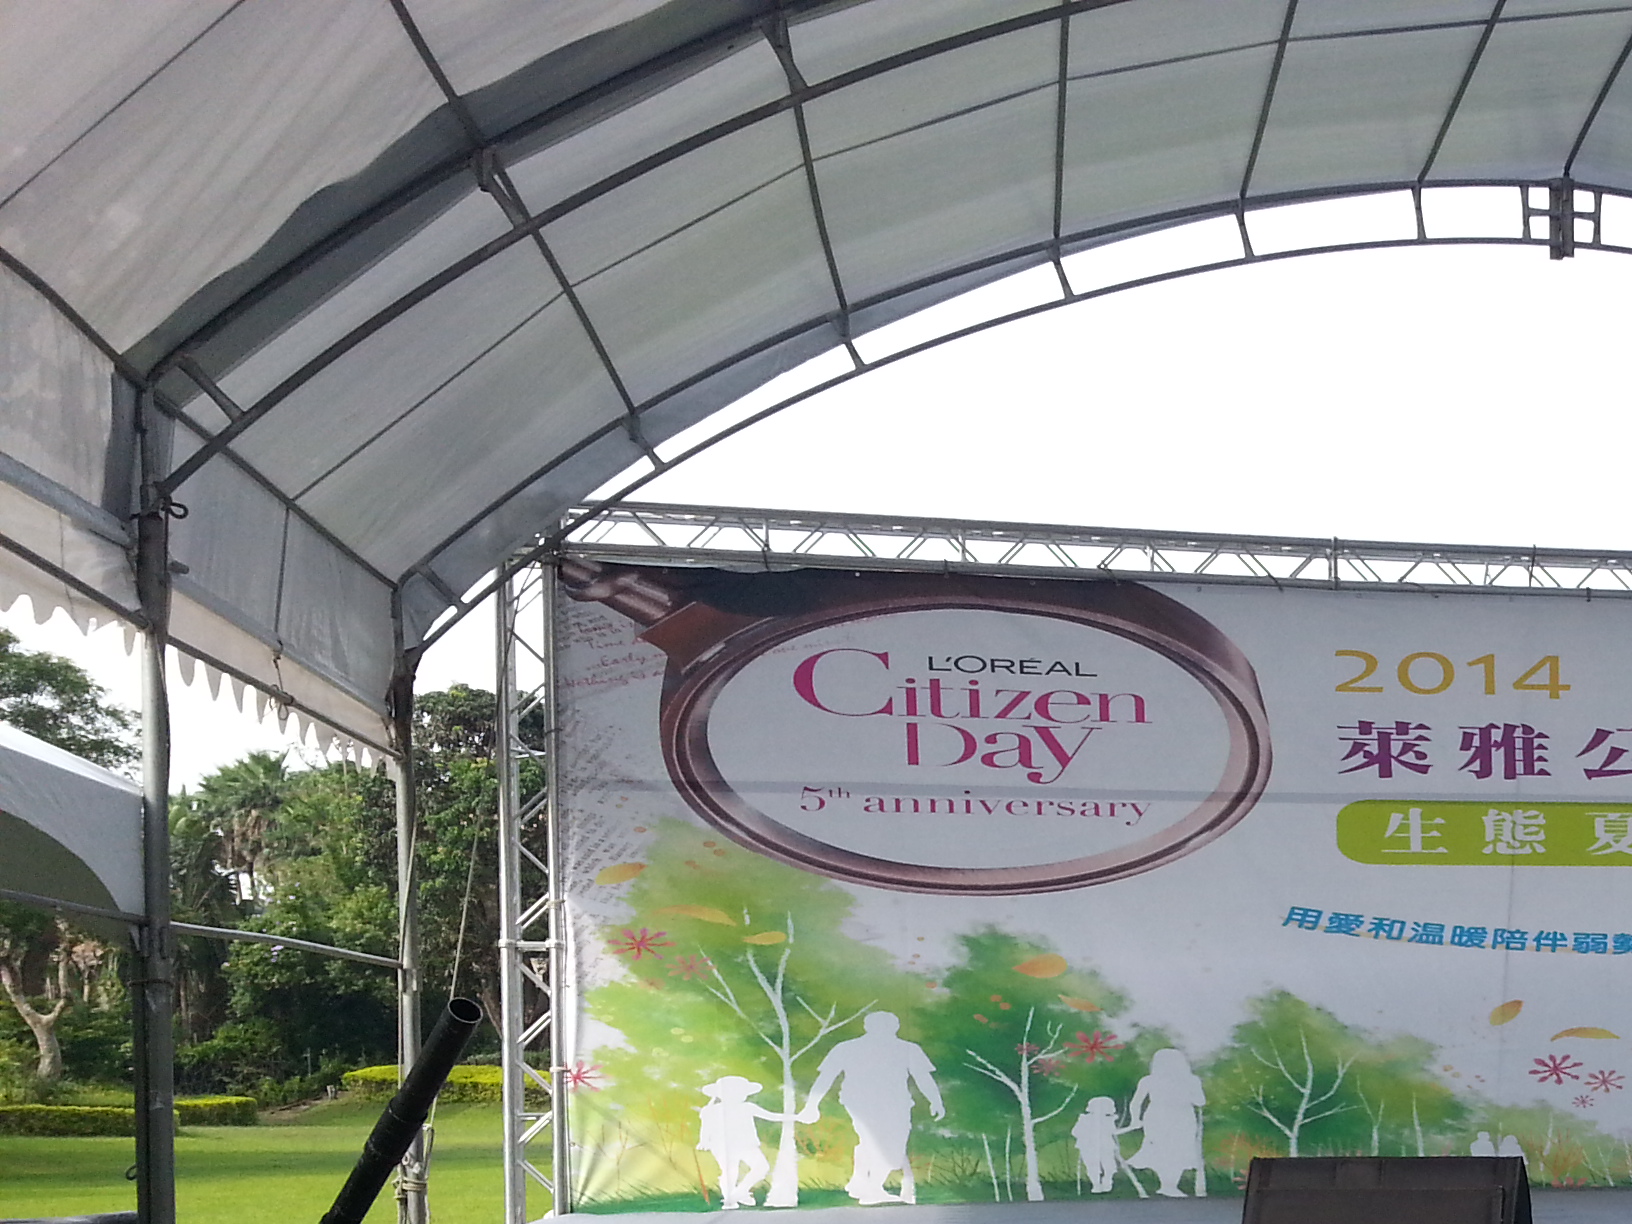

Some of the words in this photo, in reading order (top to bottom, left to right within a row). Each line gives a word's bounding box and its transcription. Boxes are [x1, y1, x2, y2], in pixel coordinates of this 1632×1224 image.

[792, 647, 1154, 725] Citizen
[1334, 648, 1572, 700] 2014
[903, 721, 1104, 785] Day
[863, 790, 1153, 827] anniversary
